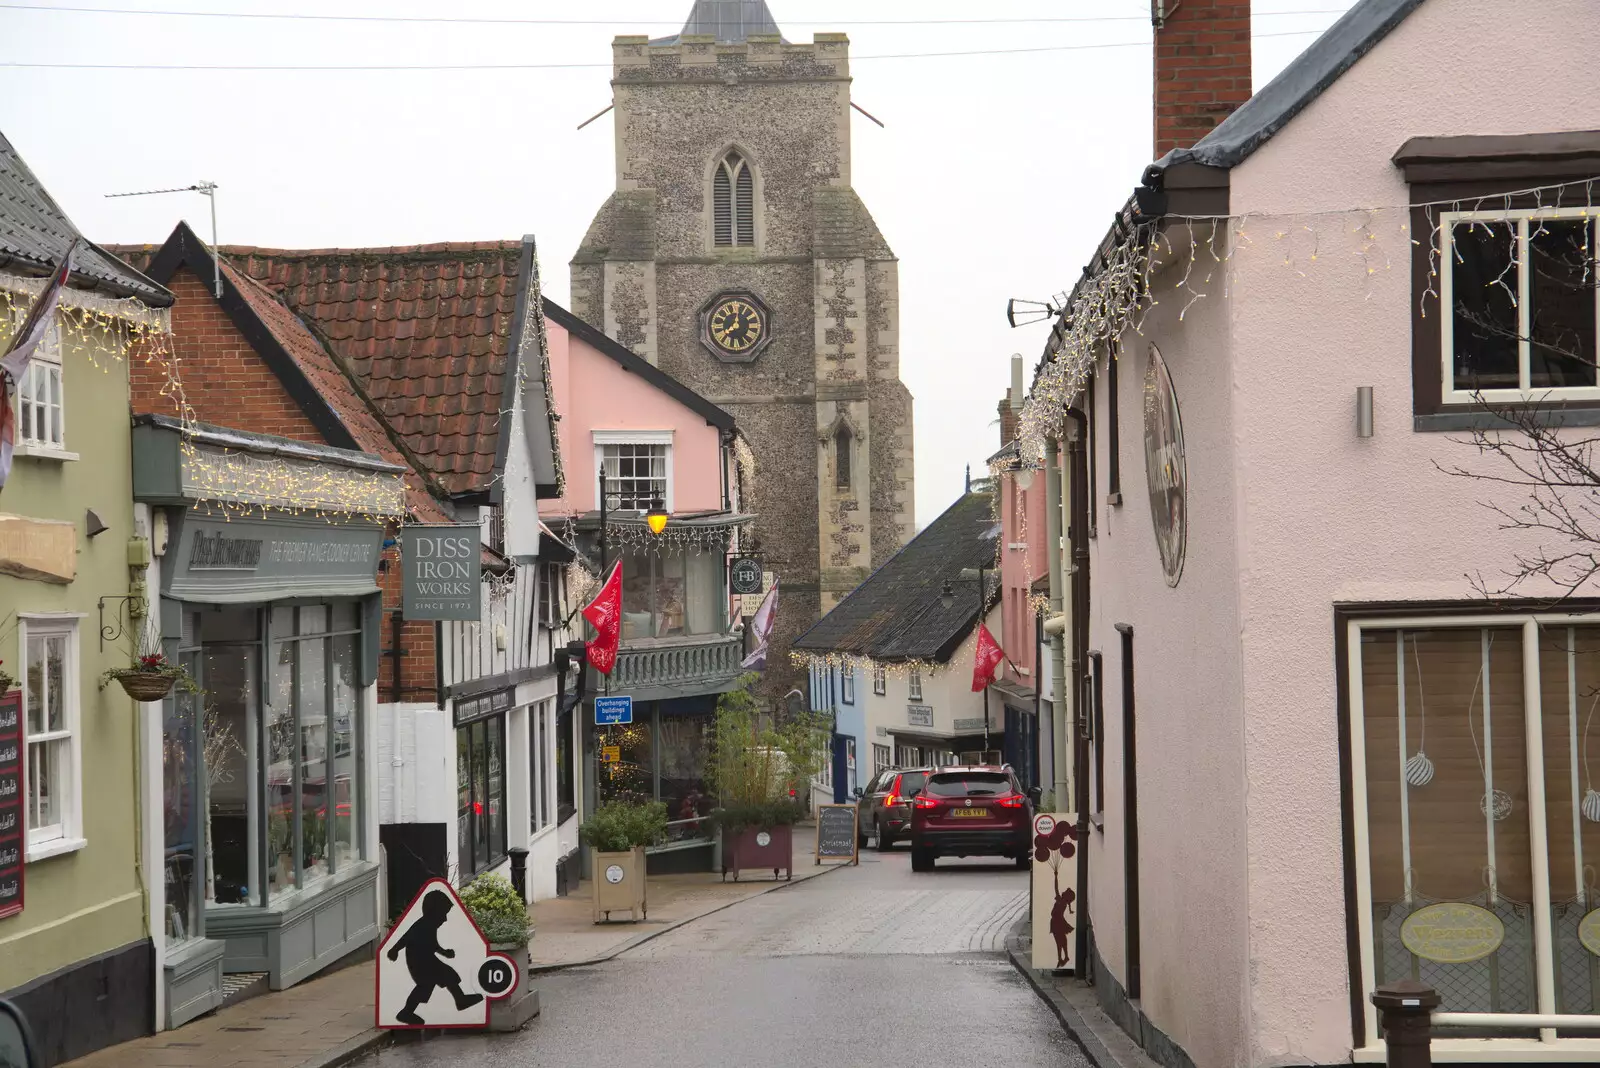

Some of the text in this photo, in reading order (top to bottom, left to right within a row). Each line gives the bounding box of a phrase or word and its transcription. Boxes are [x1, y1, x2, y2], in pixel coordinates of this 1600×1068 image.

[416, 538, 471, 558] DISS
[416, 562, 470, 578] IRON
[416, 582, 471, 594] WORKS
[488, 969, 503, 983] 10
